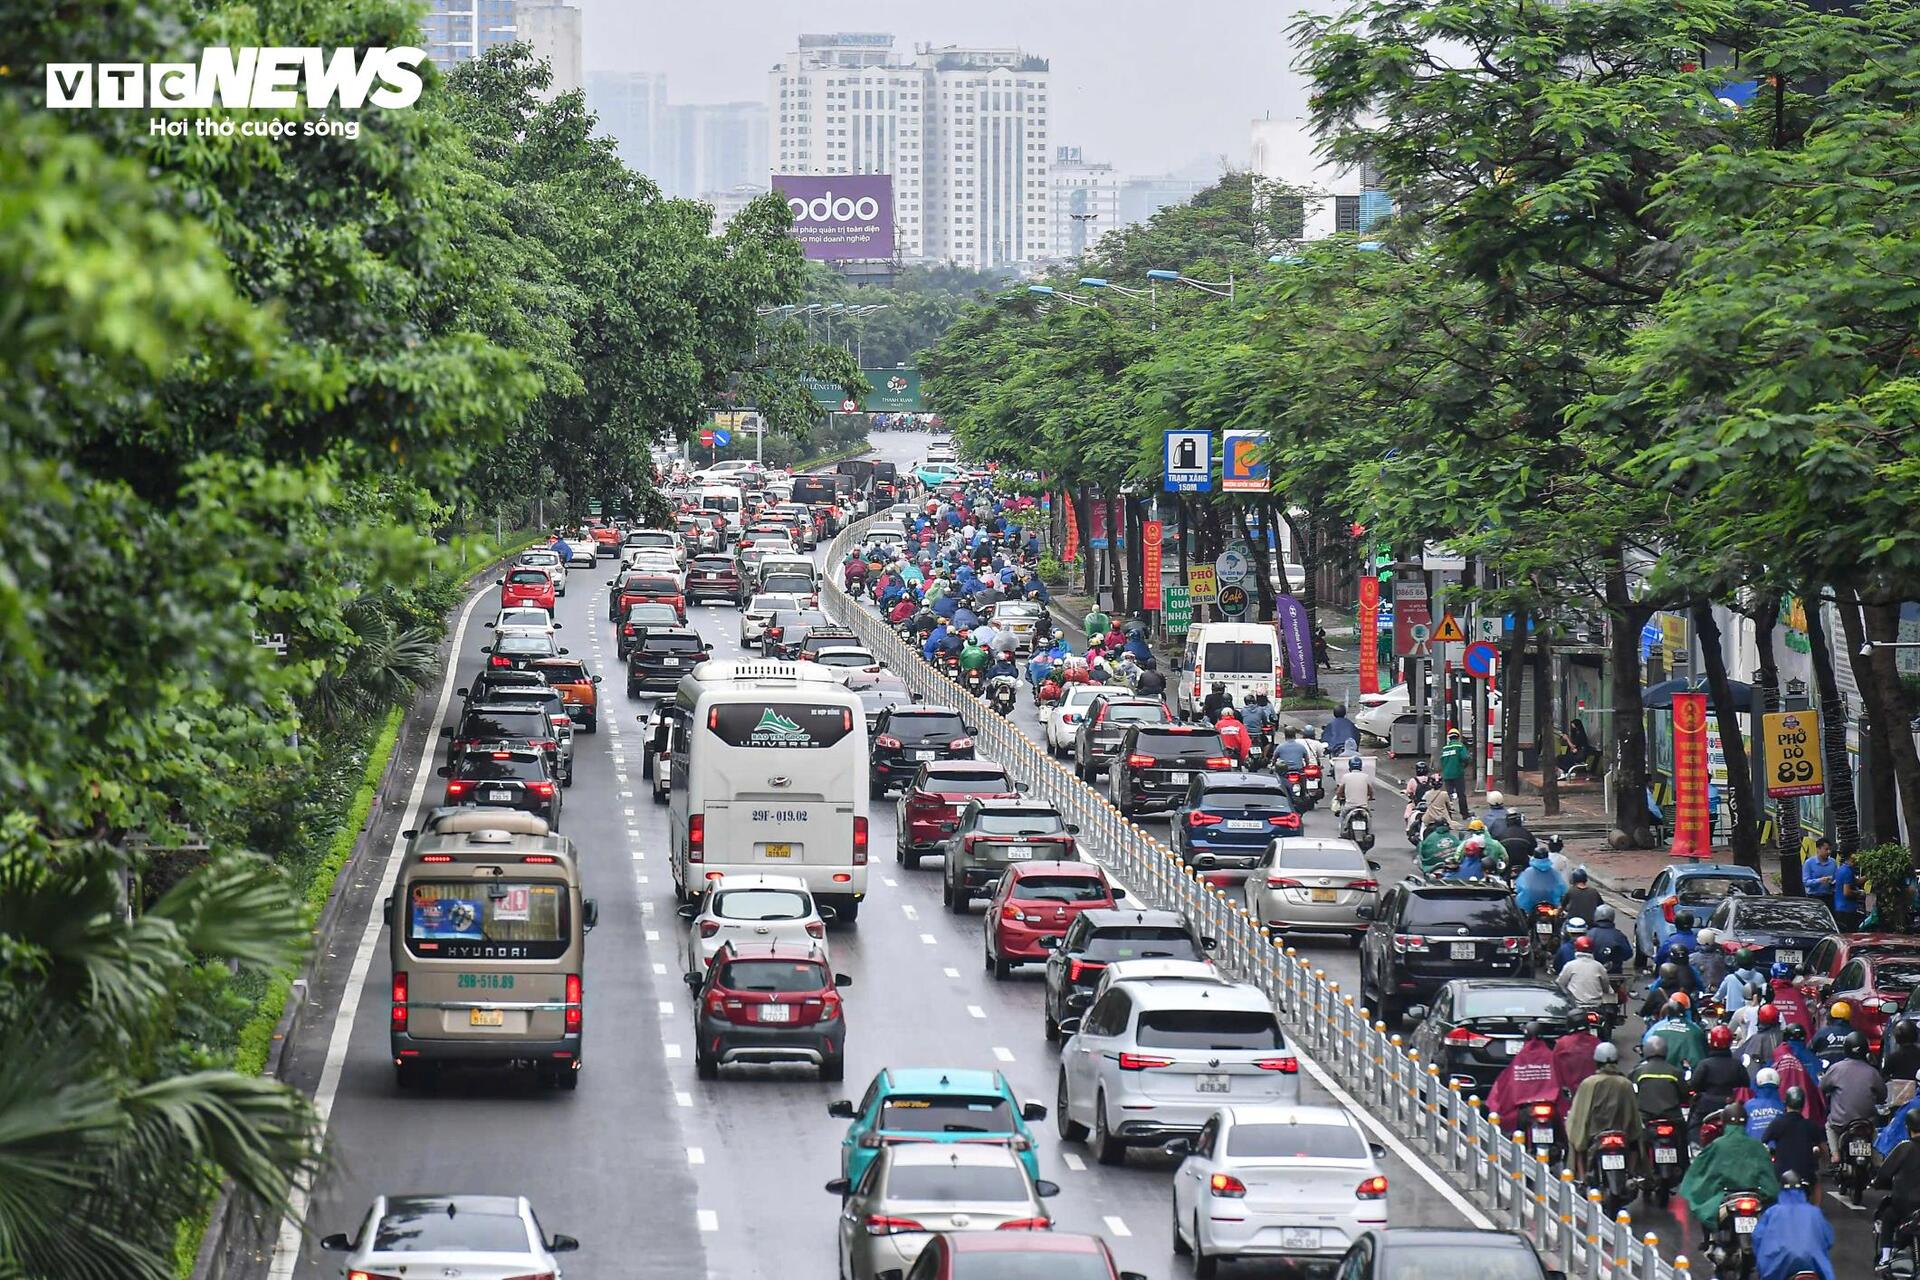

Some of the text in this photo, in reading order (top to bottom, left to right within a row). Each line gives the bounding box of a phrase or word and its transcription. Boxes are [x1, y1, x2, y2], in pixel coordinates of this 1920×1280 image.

[787, 191, 879, 221] odoo
[800, 225, 818, 234] pháp
[837, 225, 846, 235] trị
[846, 225, 863, 233] toàn
[864, 224, 880, 233] diện
[808, 235, 822, 243] mọi
[822, 234, 845, 243] doanh
[846, 234, 871, 243] nghiệp
[1168, 474, 1188, 484] TRẠM
[1179, 483, 1197, 491] 150M
[1190, 566, 1213, 580] PHỞ
[1170, 588, 1190, 596] HOA
[1194, 581, 1211, 592] GÀ
[1171, 598, 1191, 608] QUẢ
[1778, 728, 1807, 745] PHỞ
[1783, 744, 1804, 759] BÒ
[1777, 760, 1814, 783] 89
[448, 947, 528, 957] HYUNDAI
